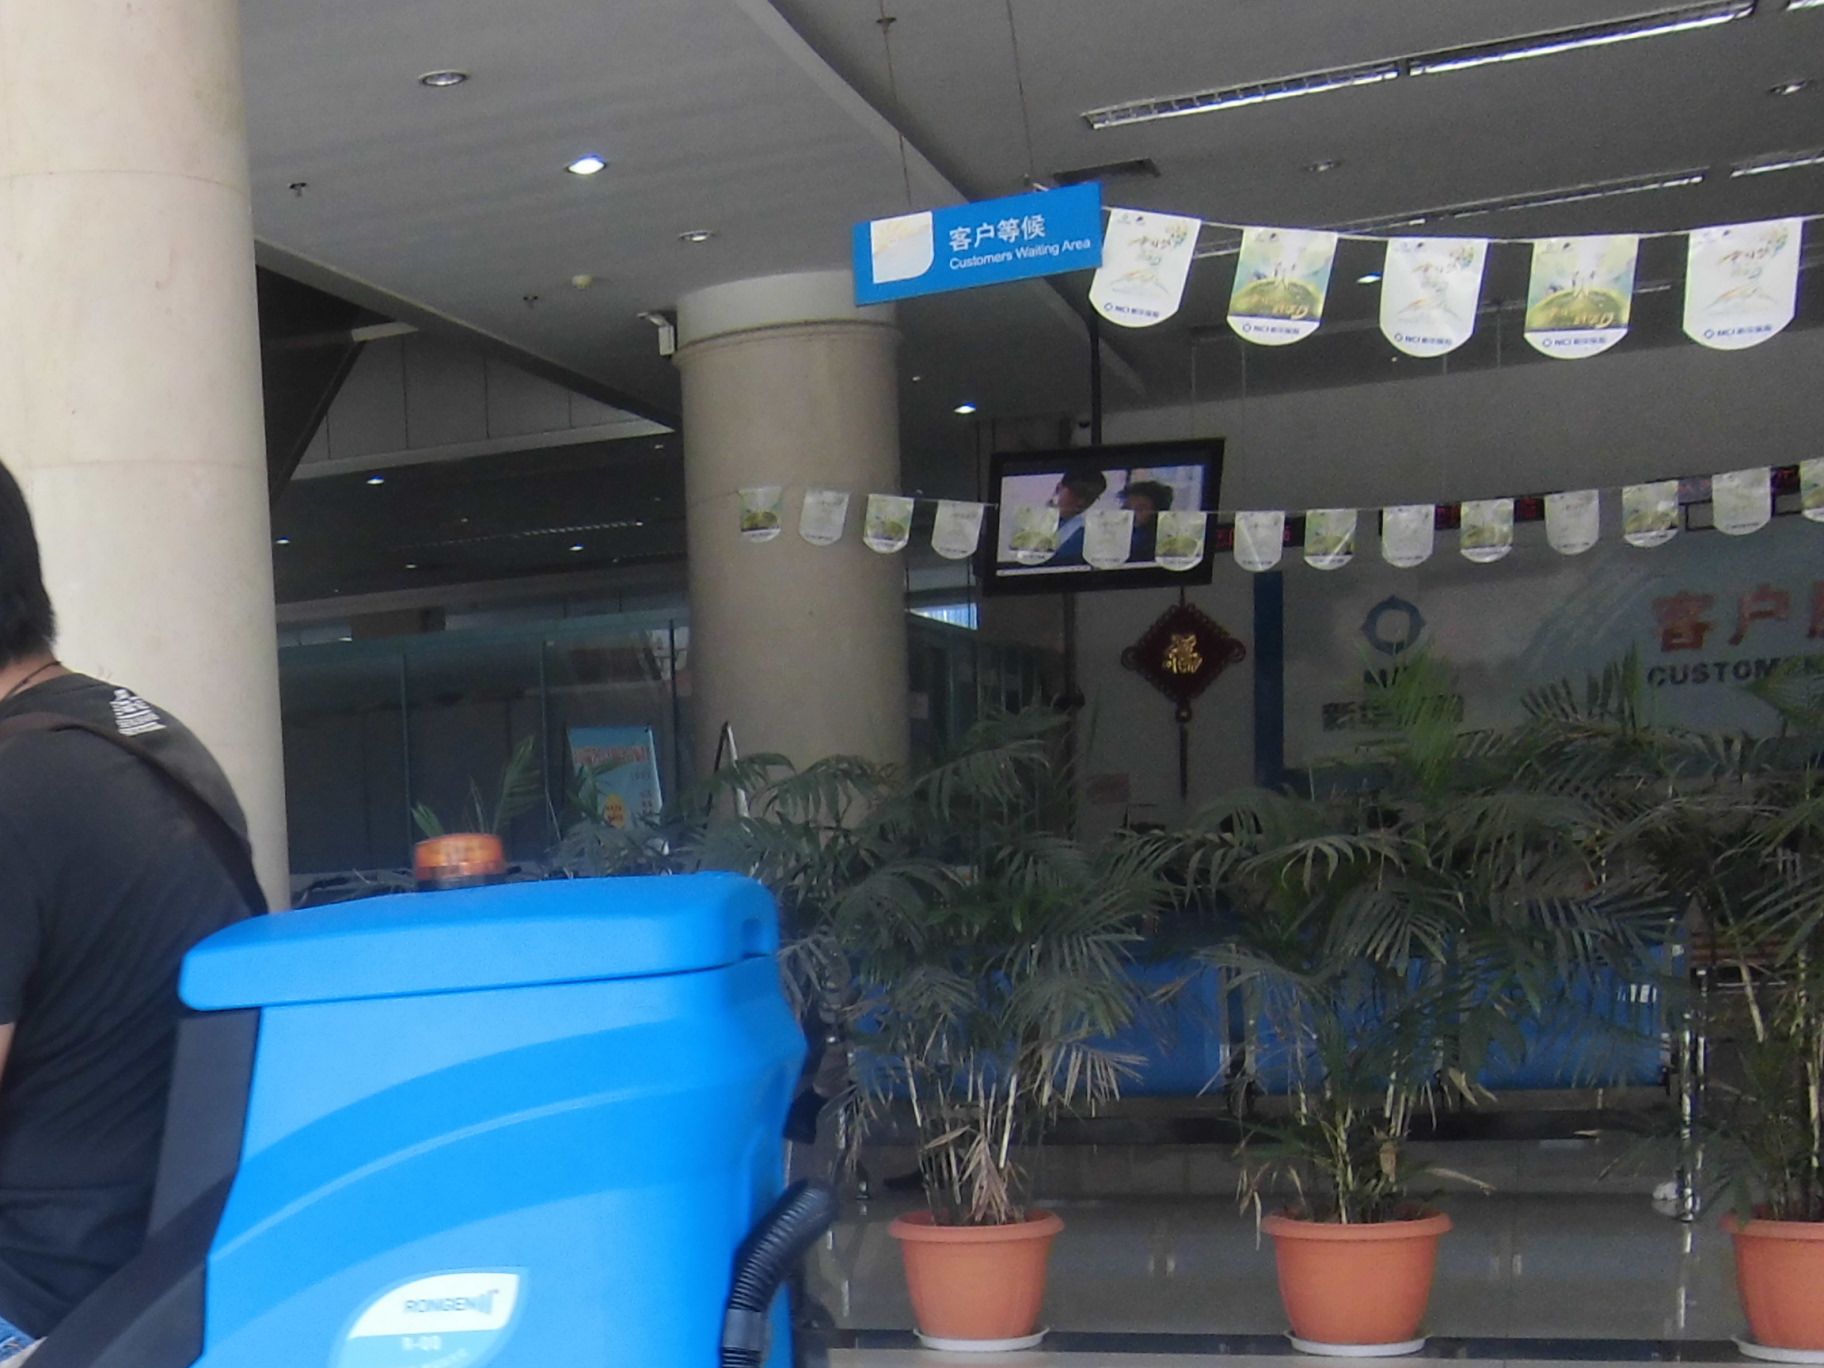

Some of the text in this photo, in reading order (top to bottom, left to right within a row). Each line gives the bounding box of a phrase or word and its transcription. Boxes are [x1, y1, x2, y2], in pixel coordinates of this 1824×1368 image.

[949, 214, 1045, 252] 客户等候
[949, 238, 1091, 270] Customers Waiting Area
[1652, 582, 1824, 652] 客户
[1647, 657, 1783, 687] CUSTOM
